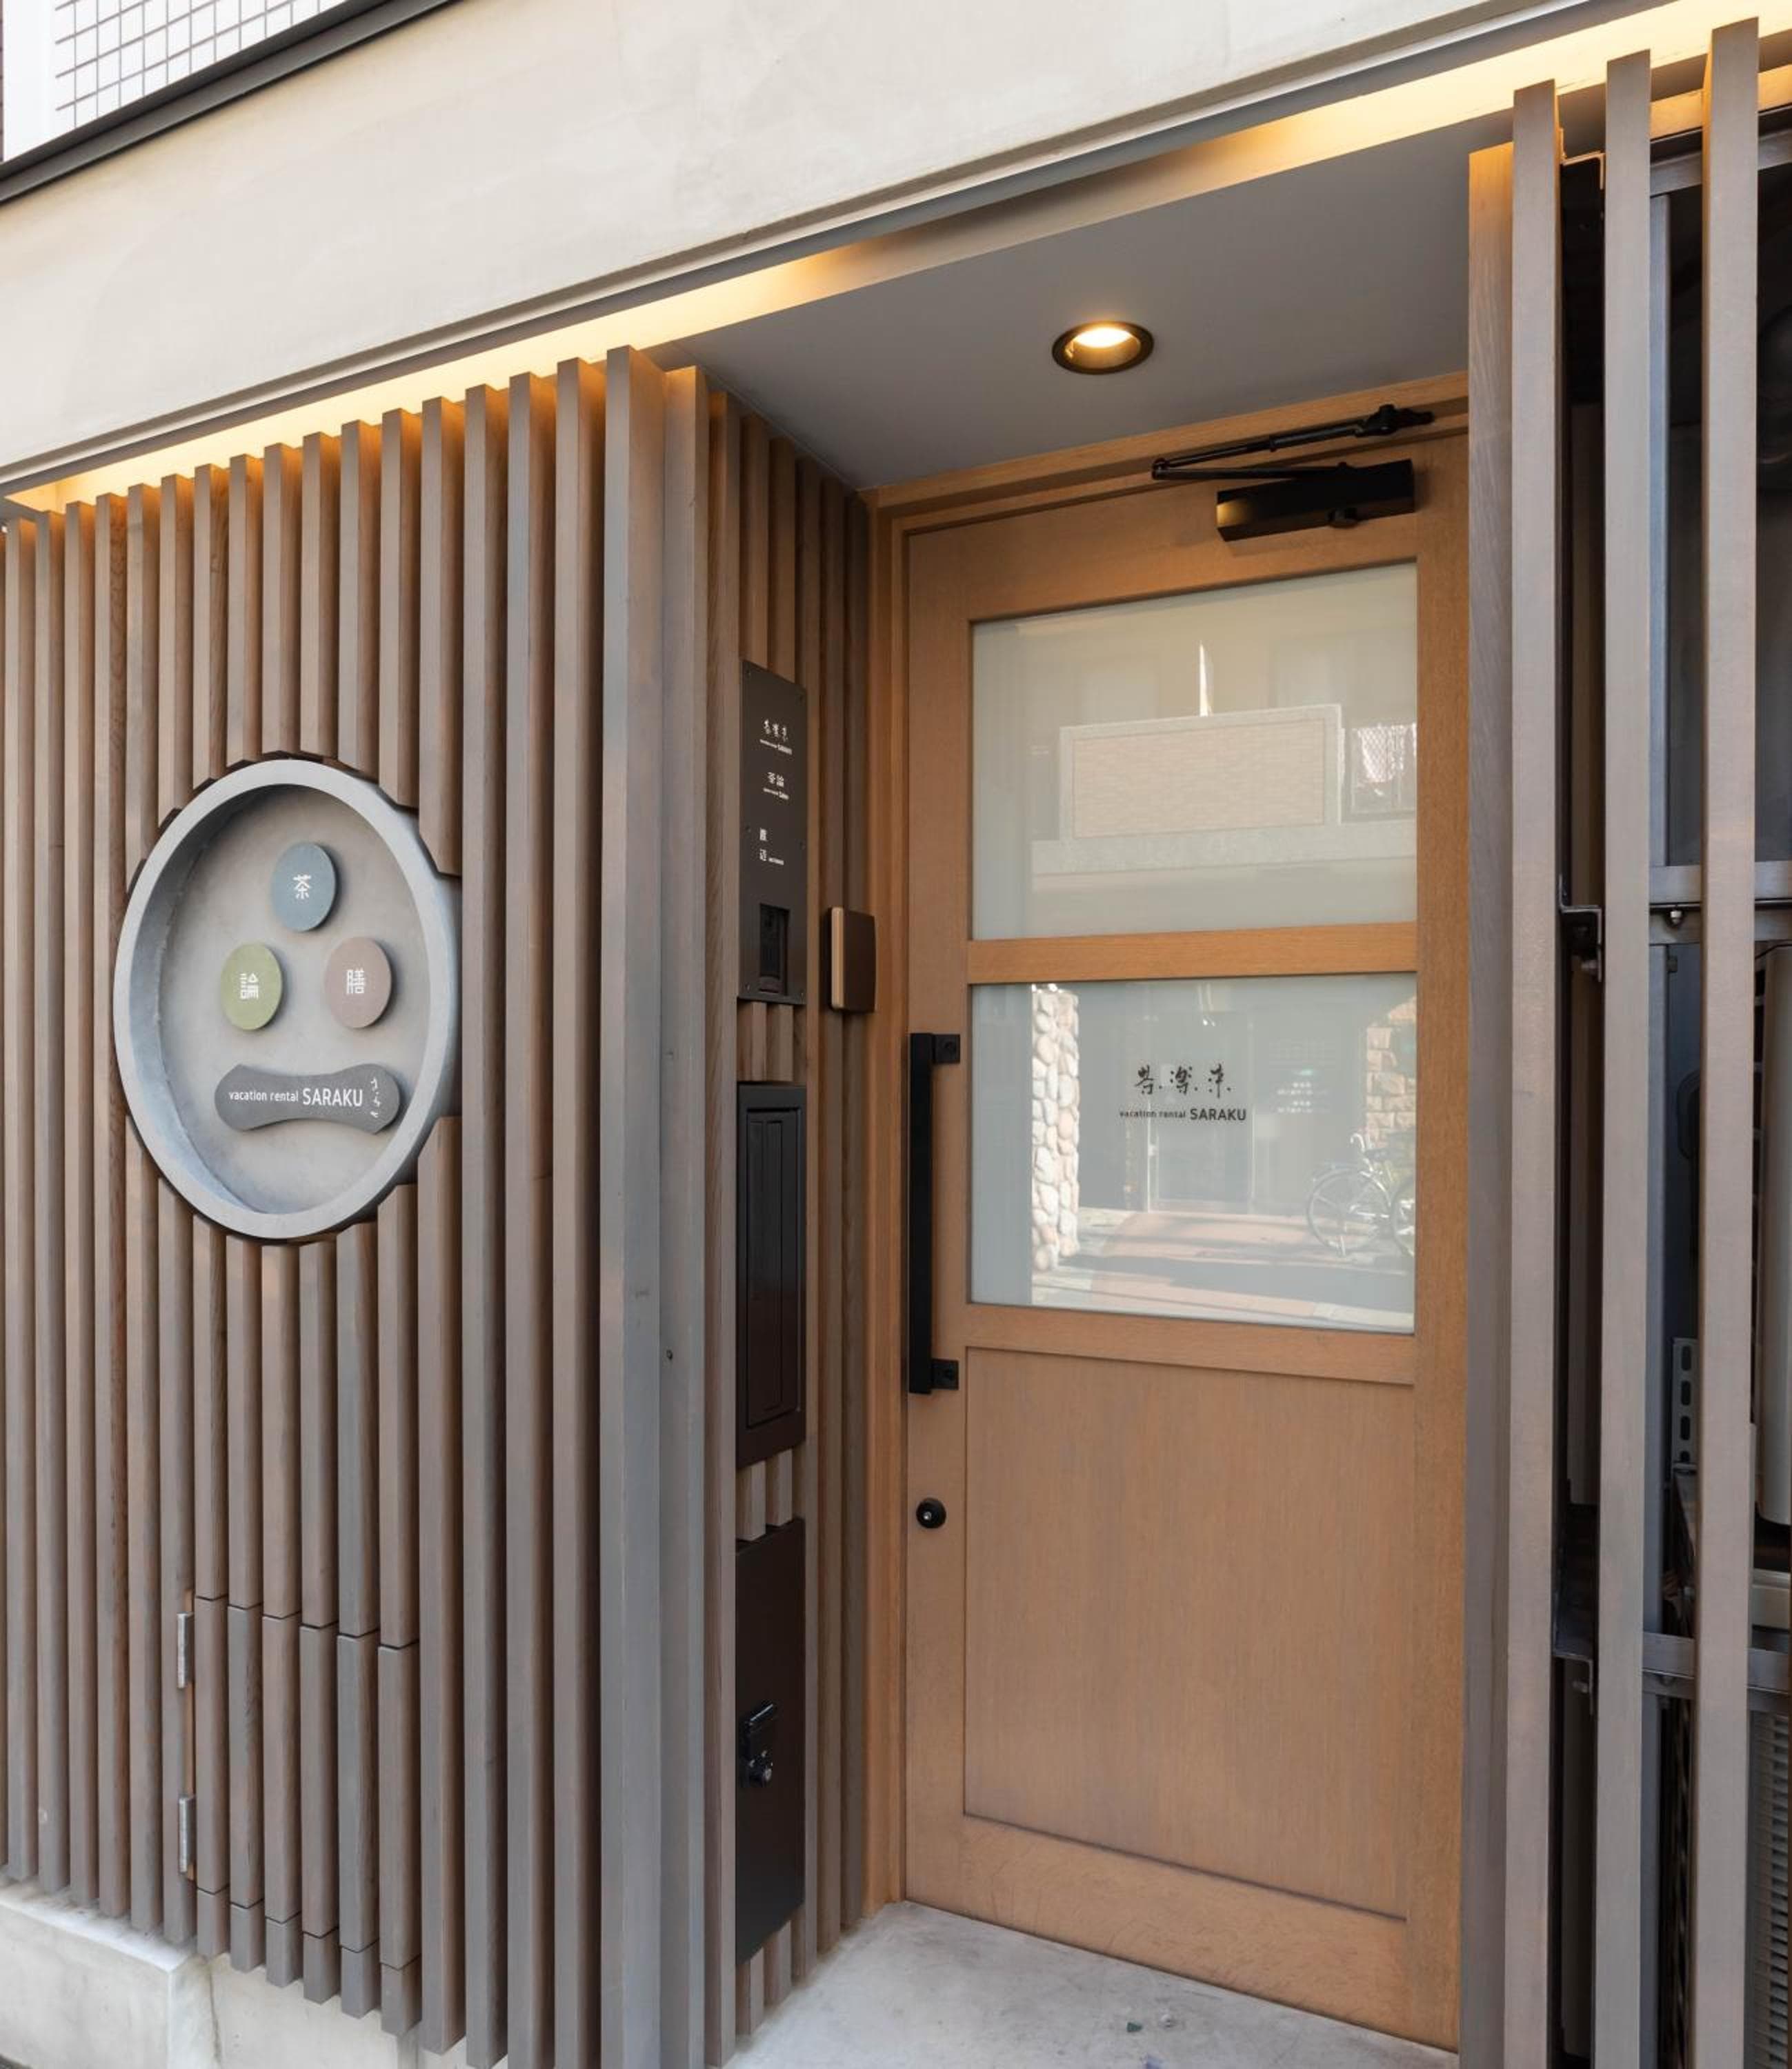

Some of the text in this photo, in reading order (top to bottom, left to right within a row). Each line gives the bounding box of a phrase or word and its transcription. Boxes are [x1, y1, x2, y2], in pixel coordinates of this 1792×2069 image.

[293, 874, 311, 899] 茶
[239, 973, 259, 999] 論
[347, 968, 365, 994] 膳
[228, 1088, 363, 1107] vacation rental SARAKU
[1119, 1108, 1247, 1121] vacation rental SARAKU
